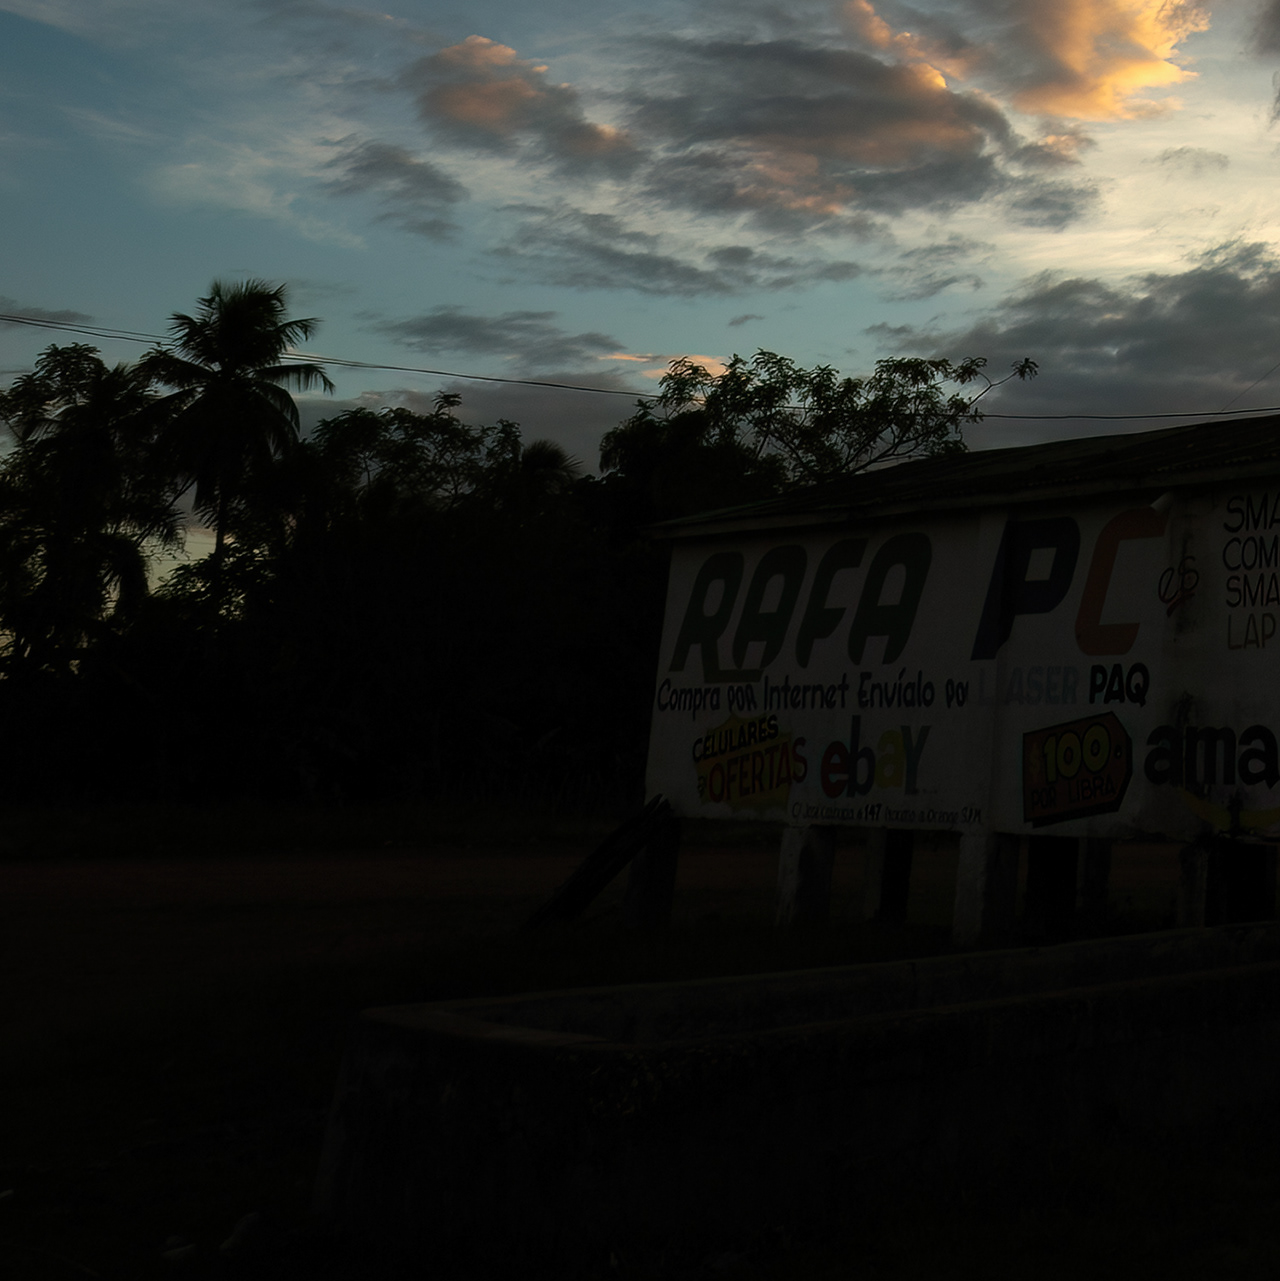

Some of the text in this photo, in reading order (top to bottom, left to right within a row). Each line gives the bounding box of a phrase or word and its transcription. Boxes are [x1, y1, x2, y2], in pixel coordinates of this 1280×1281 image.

[668, 506, 1169, 683] RAFA PC
[657, 677, 721, 721] Compra
[764, 673, 850, 711] Internet
[858, 667, 935, 708] Envíalo
[1088, 662, 1150, 708] PAQ
[692, 714, 779, 763] CELULARES
[709, 736, 808, 803] OFERTAS
[1067, 772, 1117, 805] LIBRA
